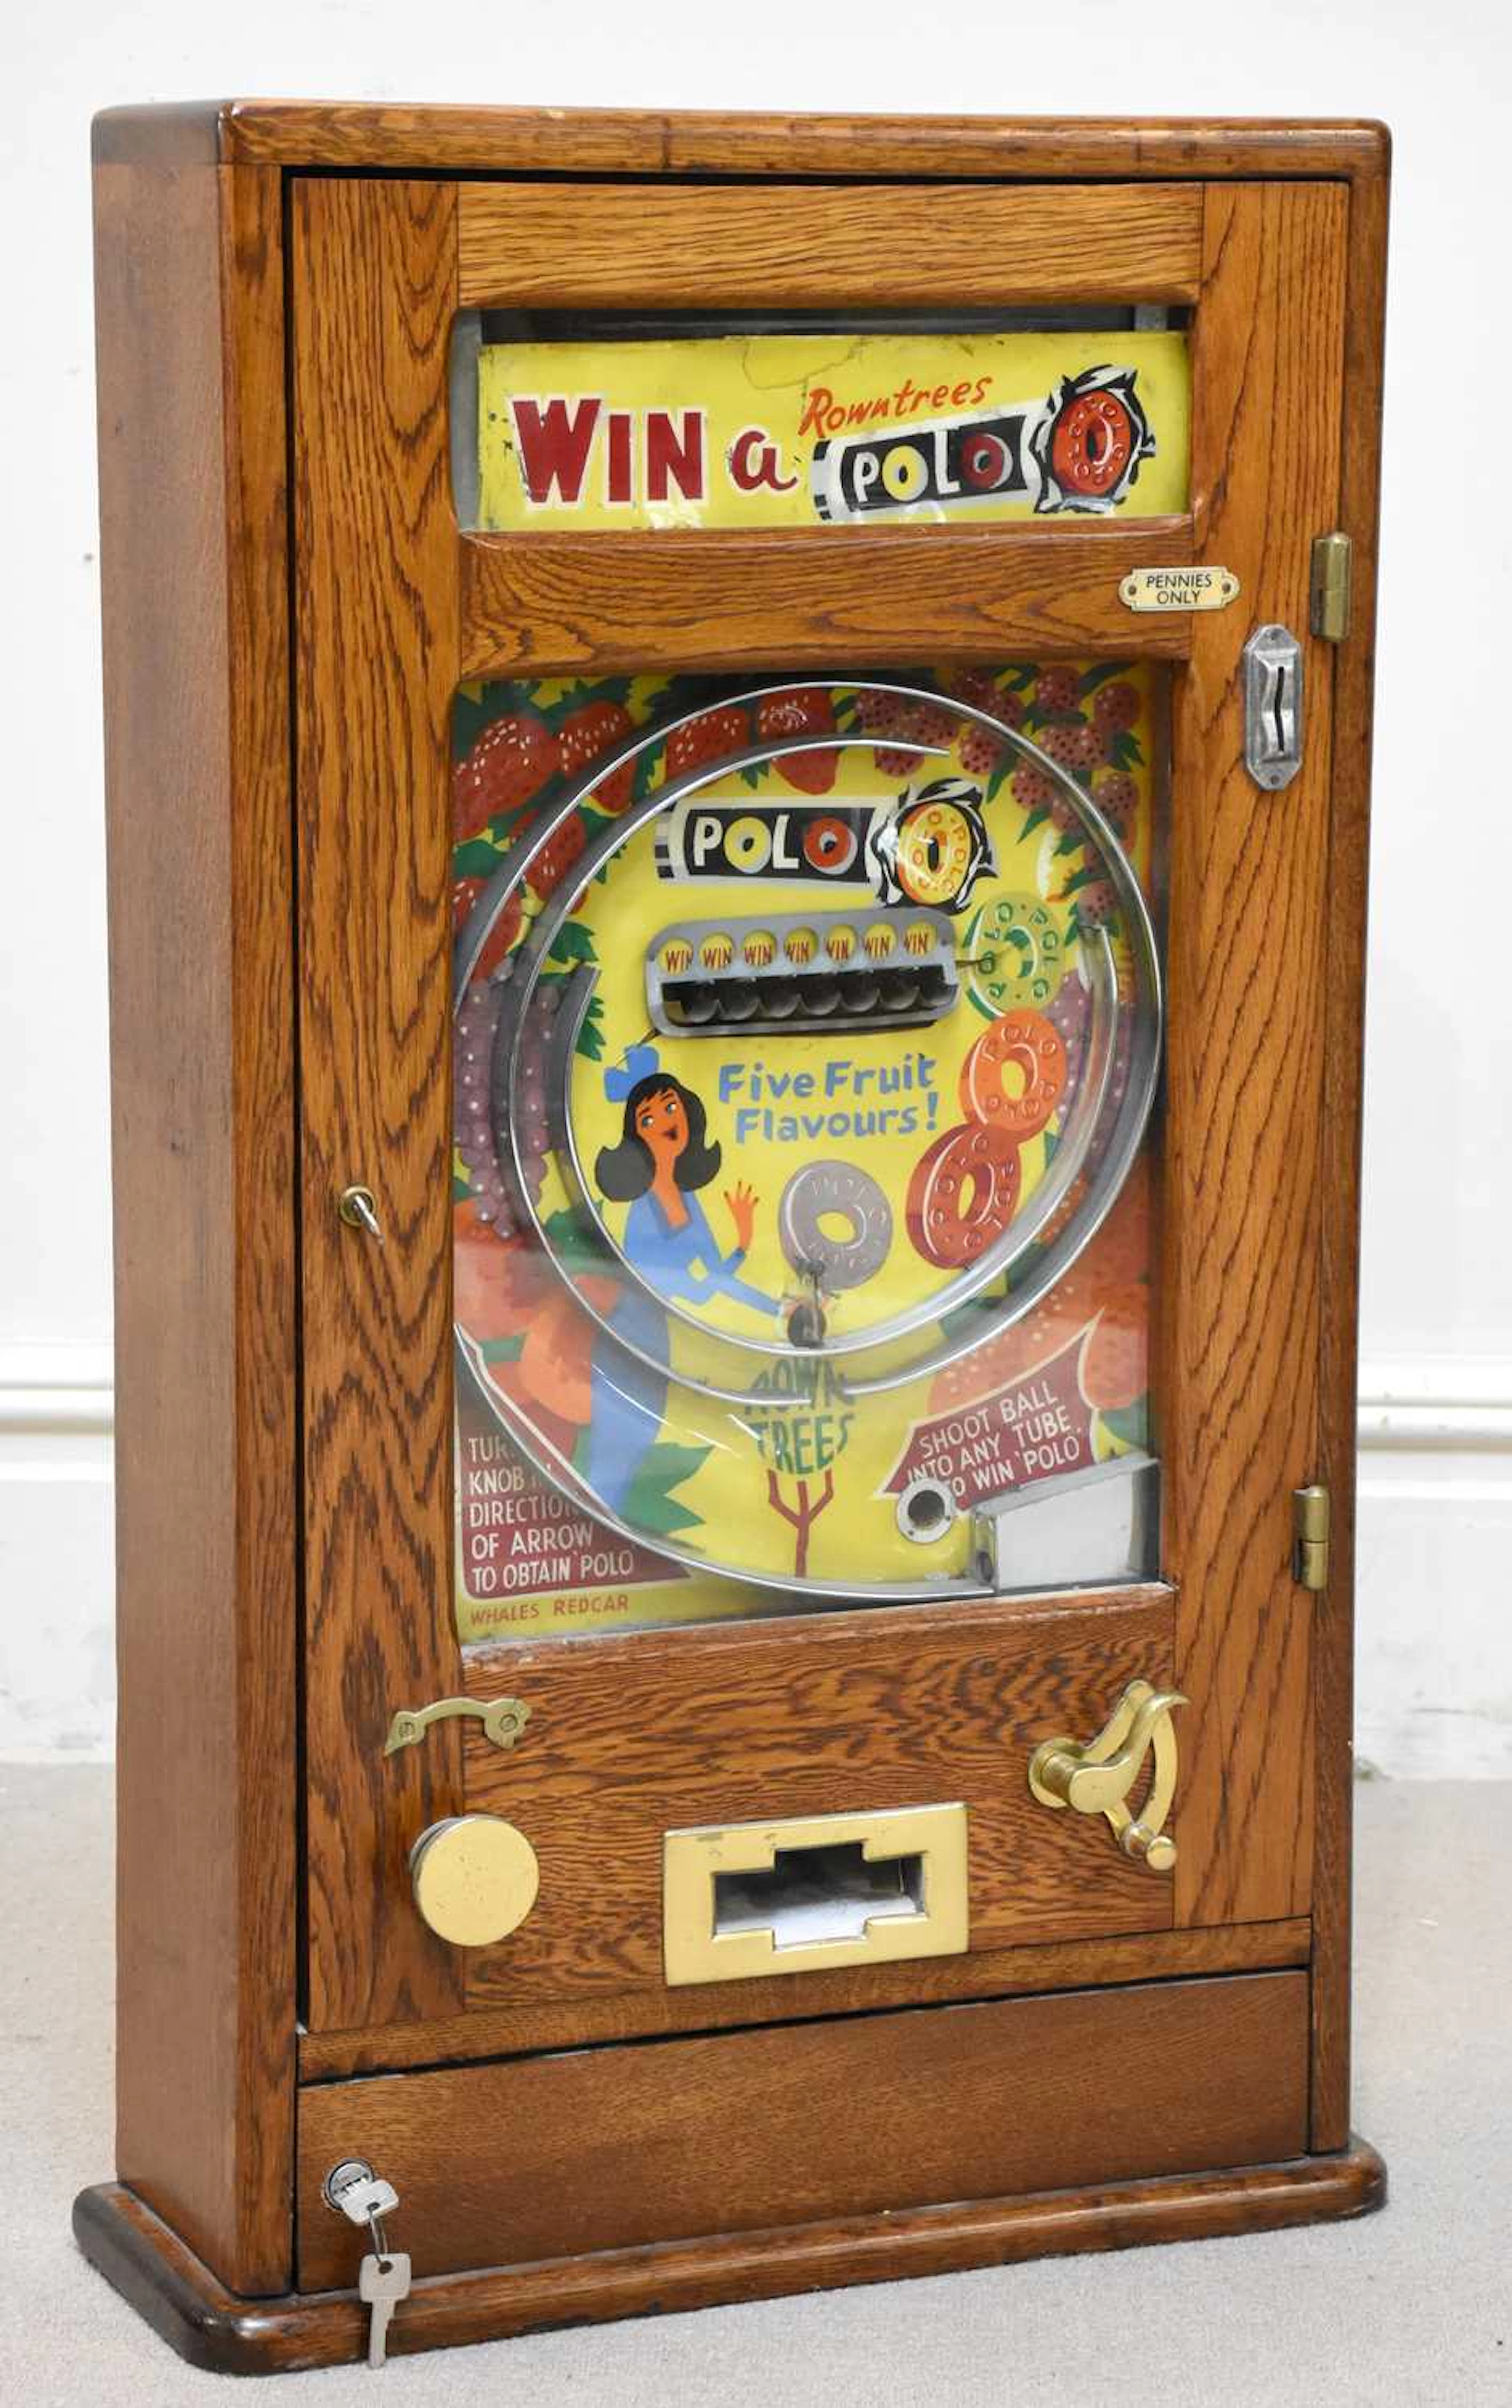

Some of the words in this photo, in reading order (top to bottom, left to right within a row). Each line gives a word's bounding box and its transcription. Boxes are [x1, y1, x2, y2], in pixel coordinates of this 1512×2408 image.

[798, 376, 993, 438] Rowntrees
[512, 398, 704, 503] WIN
[730, 430, 799, 491] a
[852, 428, 1014, 502] POLO
[1146, 573, 1213, 589] PENNIES
[1156, 590, 1200, 605] ONLY
[693, 814, 859, 875] POLO
[718, 1062, 815, 1104] Five
[825, 1053, 937, 1098] Fruit
[736, 1092, 939, 1144] Flavours!
[919, 1407, 990, 1459] SHOOT
[999, 1380, 1058, 1424] BALL
[960, 1432, 1001, 1471] ANY
[1012, 1405, 1071, 1448] TUBE
[468, 1433, 509, 1464] TUR
[469, 1465, 525, 1496] KNOB
[945, 1476, 966, 1497] O
[971, 1459, 1015, 1490] WIN
[472, 1533, 499, 1560] OF
[511, 1522, 593, 1555] ARROW
[472, 1565, 497, 1593] TO
[503, 1556, 571, 1590] OBTAIN
[469, 1603, 540, 1627] WHALES
[553, 1594, 629, 1616] REDCAR
